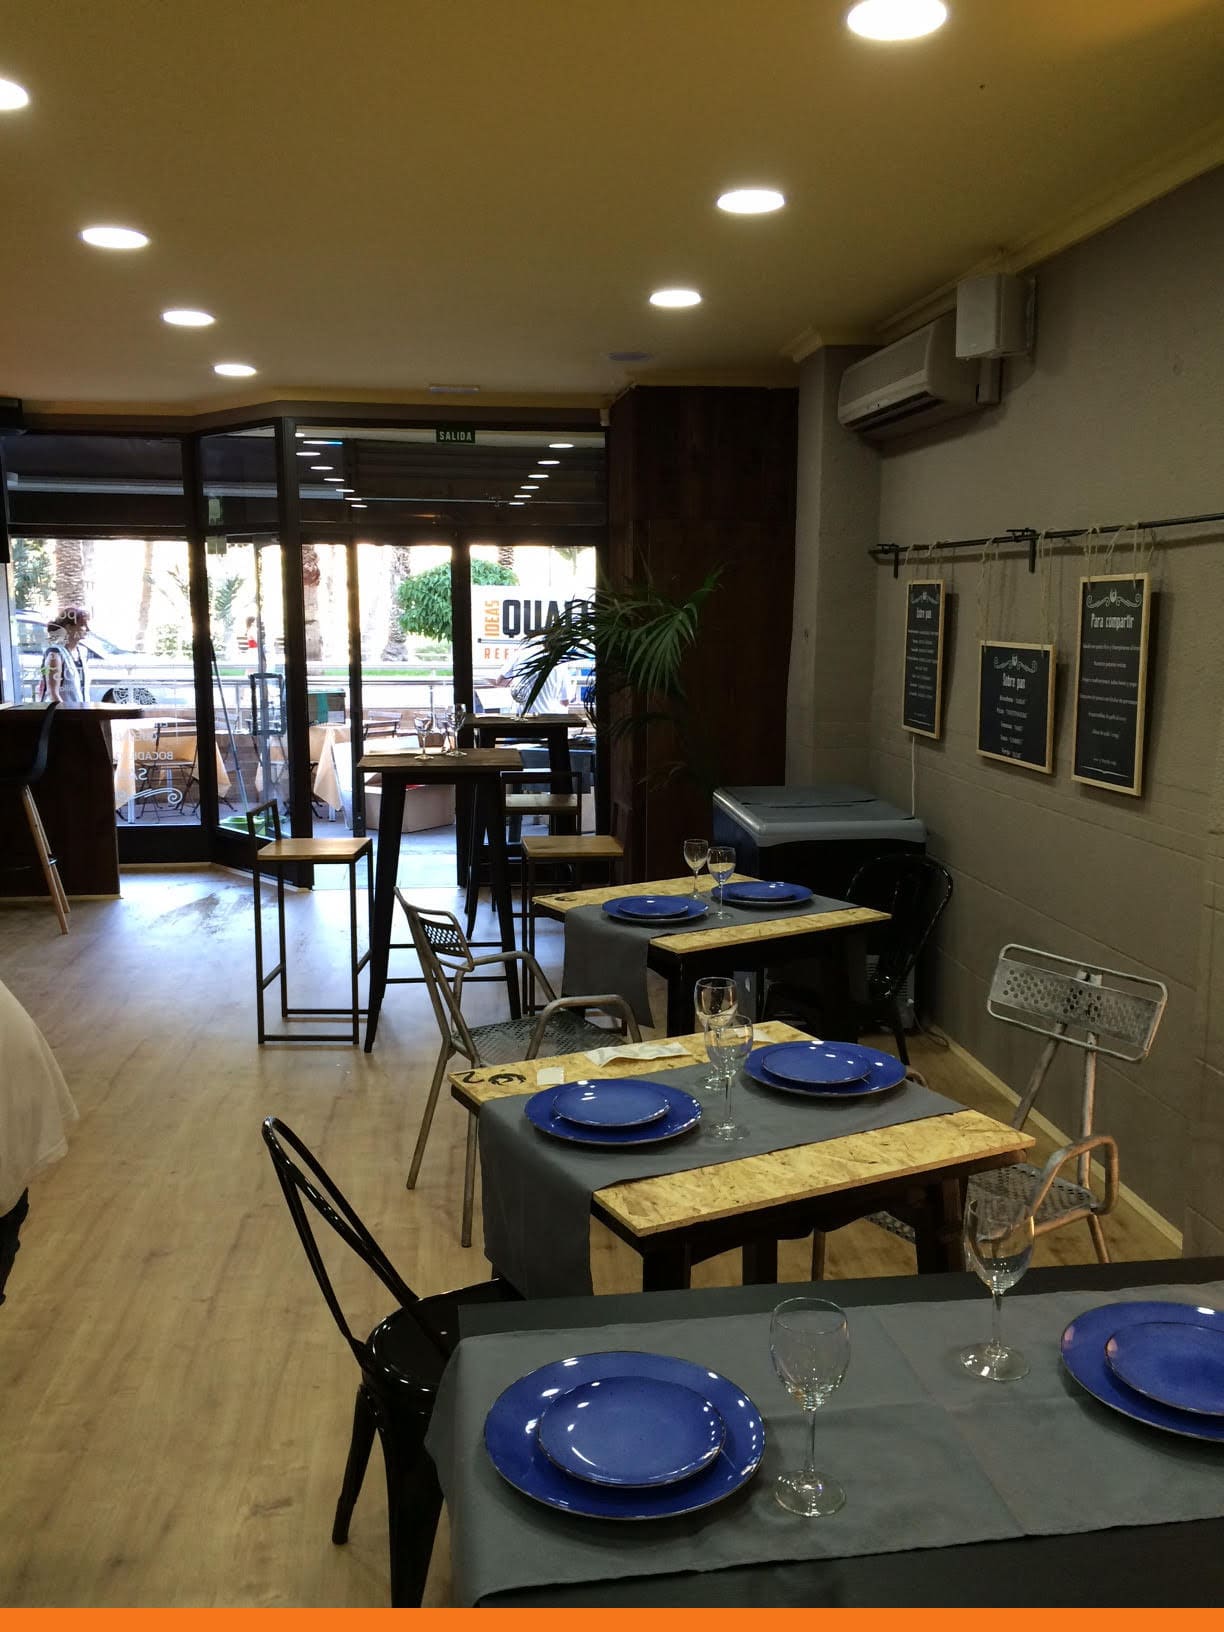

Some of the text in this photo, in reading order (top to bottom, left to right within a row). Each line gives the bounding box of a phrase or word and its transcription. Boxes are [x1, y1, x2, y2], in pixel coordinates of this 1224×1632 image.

[439, 431, 472, 441] SALIDA
[484, 600, 500, 637] IDEAS
[1090, 612, 1135, 631] Para compartir
[1016, 678, 1025, 691] pan
